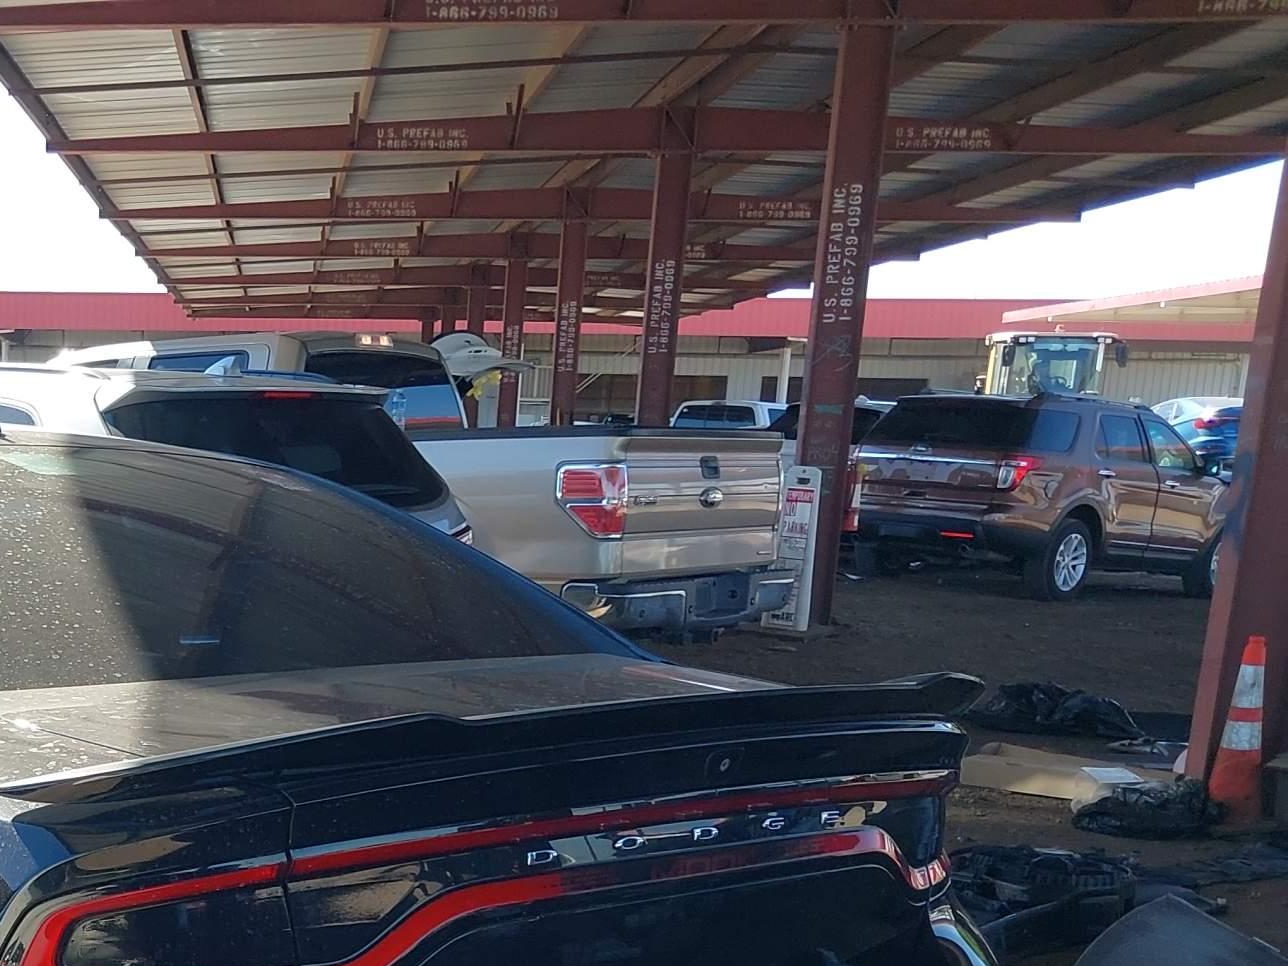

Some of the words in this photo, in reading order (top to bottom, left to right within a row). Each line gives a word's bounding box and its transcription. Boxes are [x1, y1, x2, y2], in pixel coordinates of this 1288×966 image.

[832, 183, 848, 214] INC.
[826, 223, 844, 284] PREFAB
[839, 184, 863, 322] 1-866-799-0969
[650, 285, 662, 328] PREFAB
[823, 293, 838, 323] U.S.
[527, 810, 841, 866] DODGE
